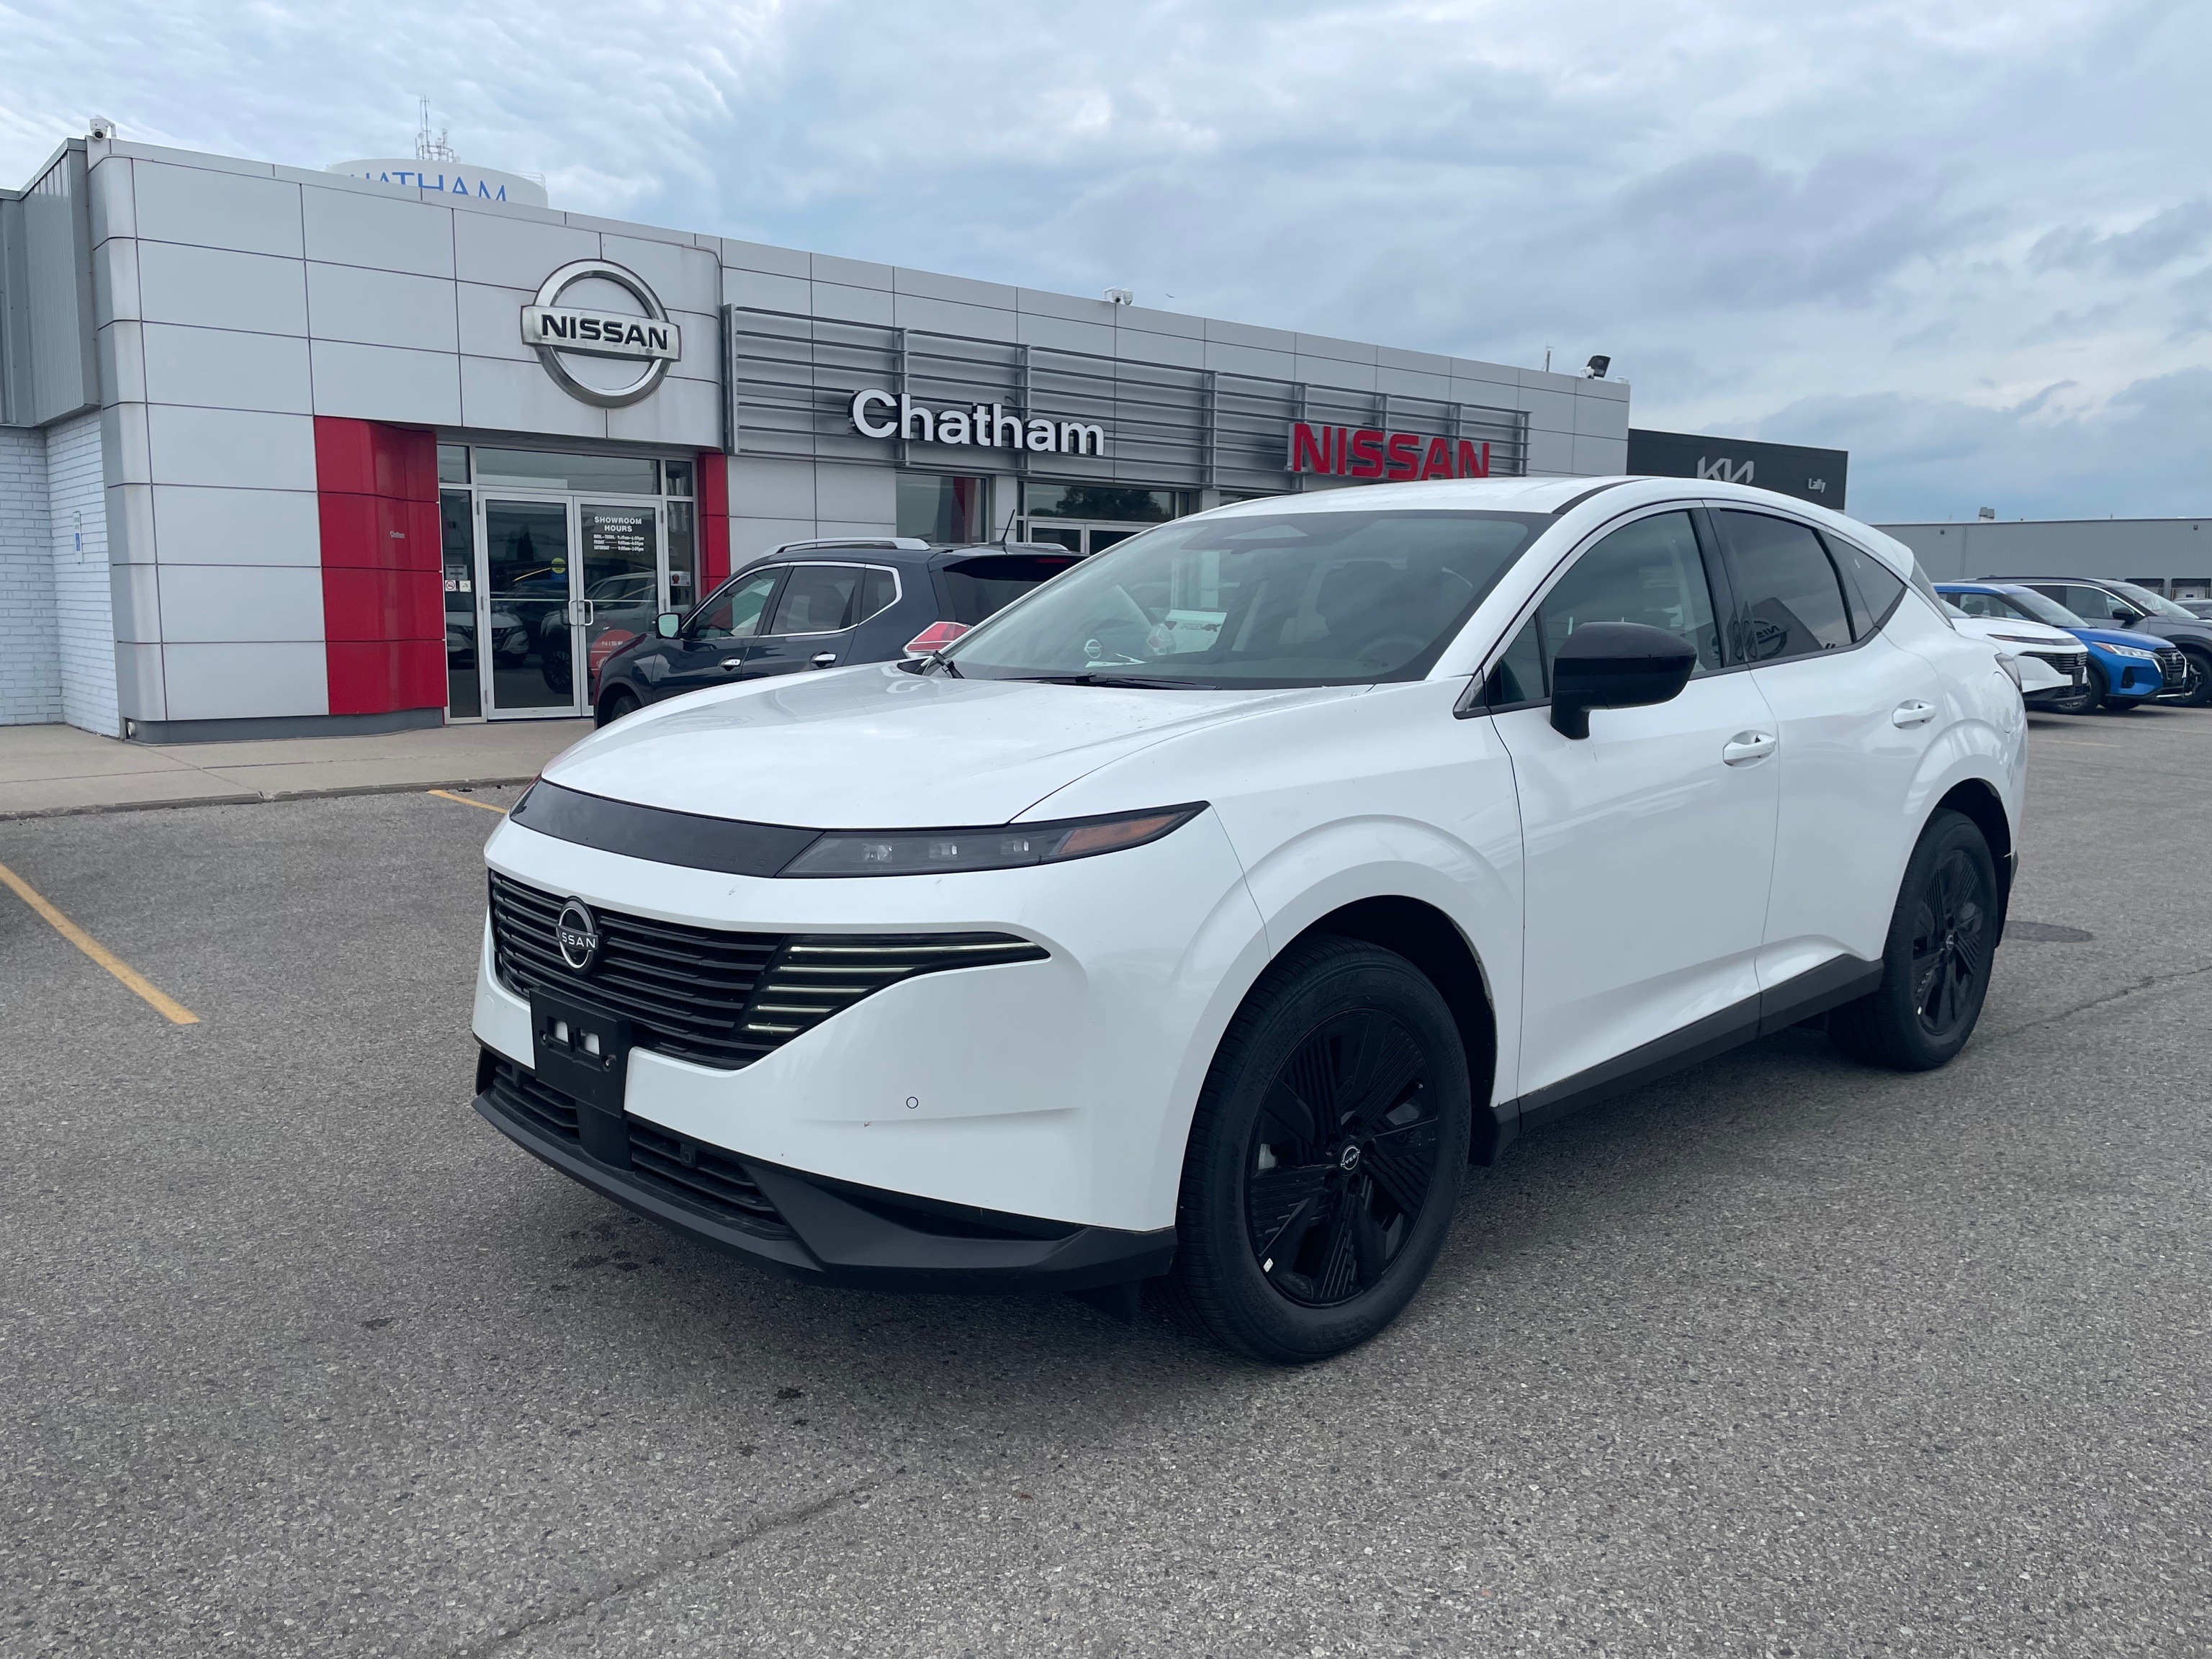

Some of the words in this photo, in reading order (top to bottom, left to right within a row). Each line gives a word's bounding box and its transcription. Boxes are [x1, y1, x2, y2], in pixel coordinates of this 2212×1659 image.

[350, 172, 506, 202] THAM
[541, 314, 667, 350] NISSAN
[851, 388, 1105, 456] Chatham
[1292, 422, 1491, 480] NISSAN
[1696, 456, 1755, 485] KIA
[1808, 477, 1827, 493] Lally
[594, 516, 642, 525] SHOWROOM
